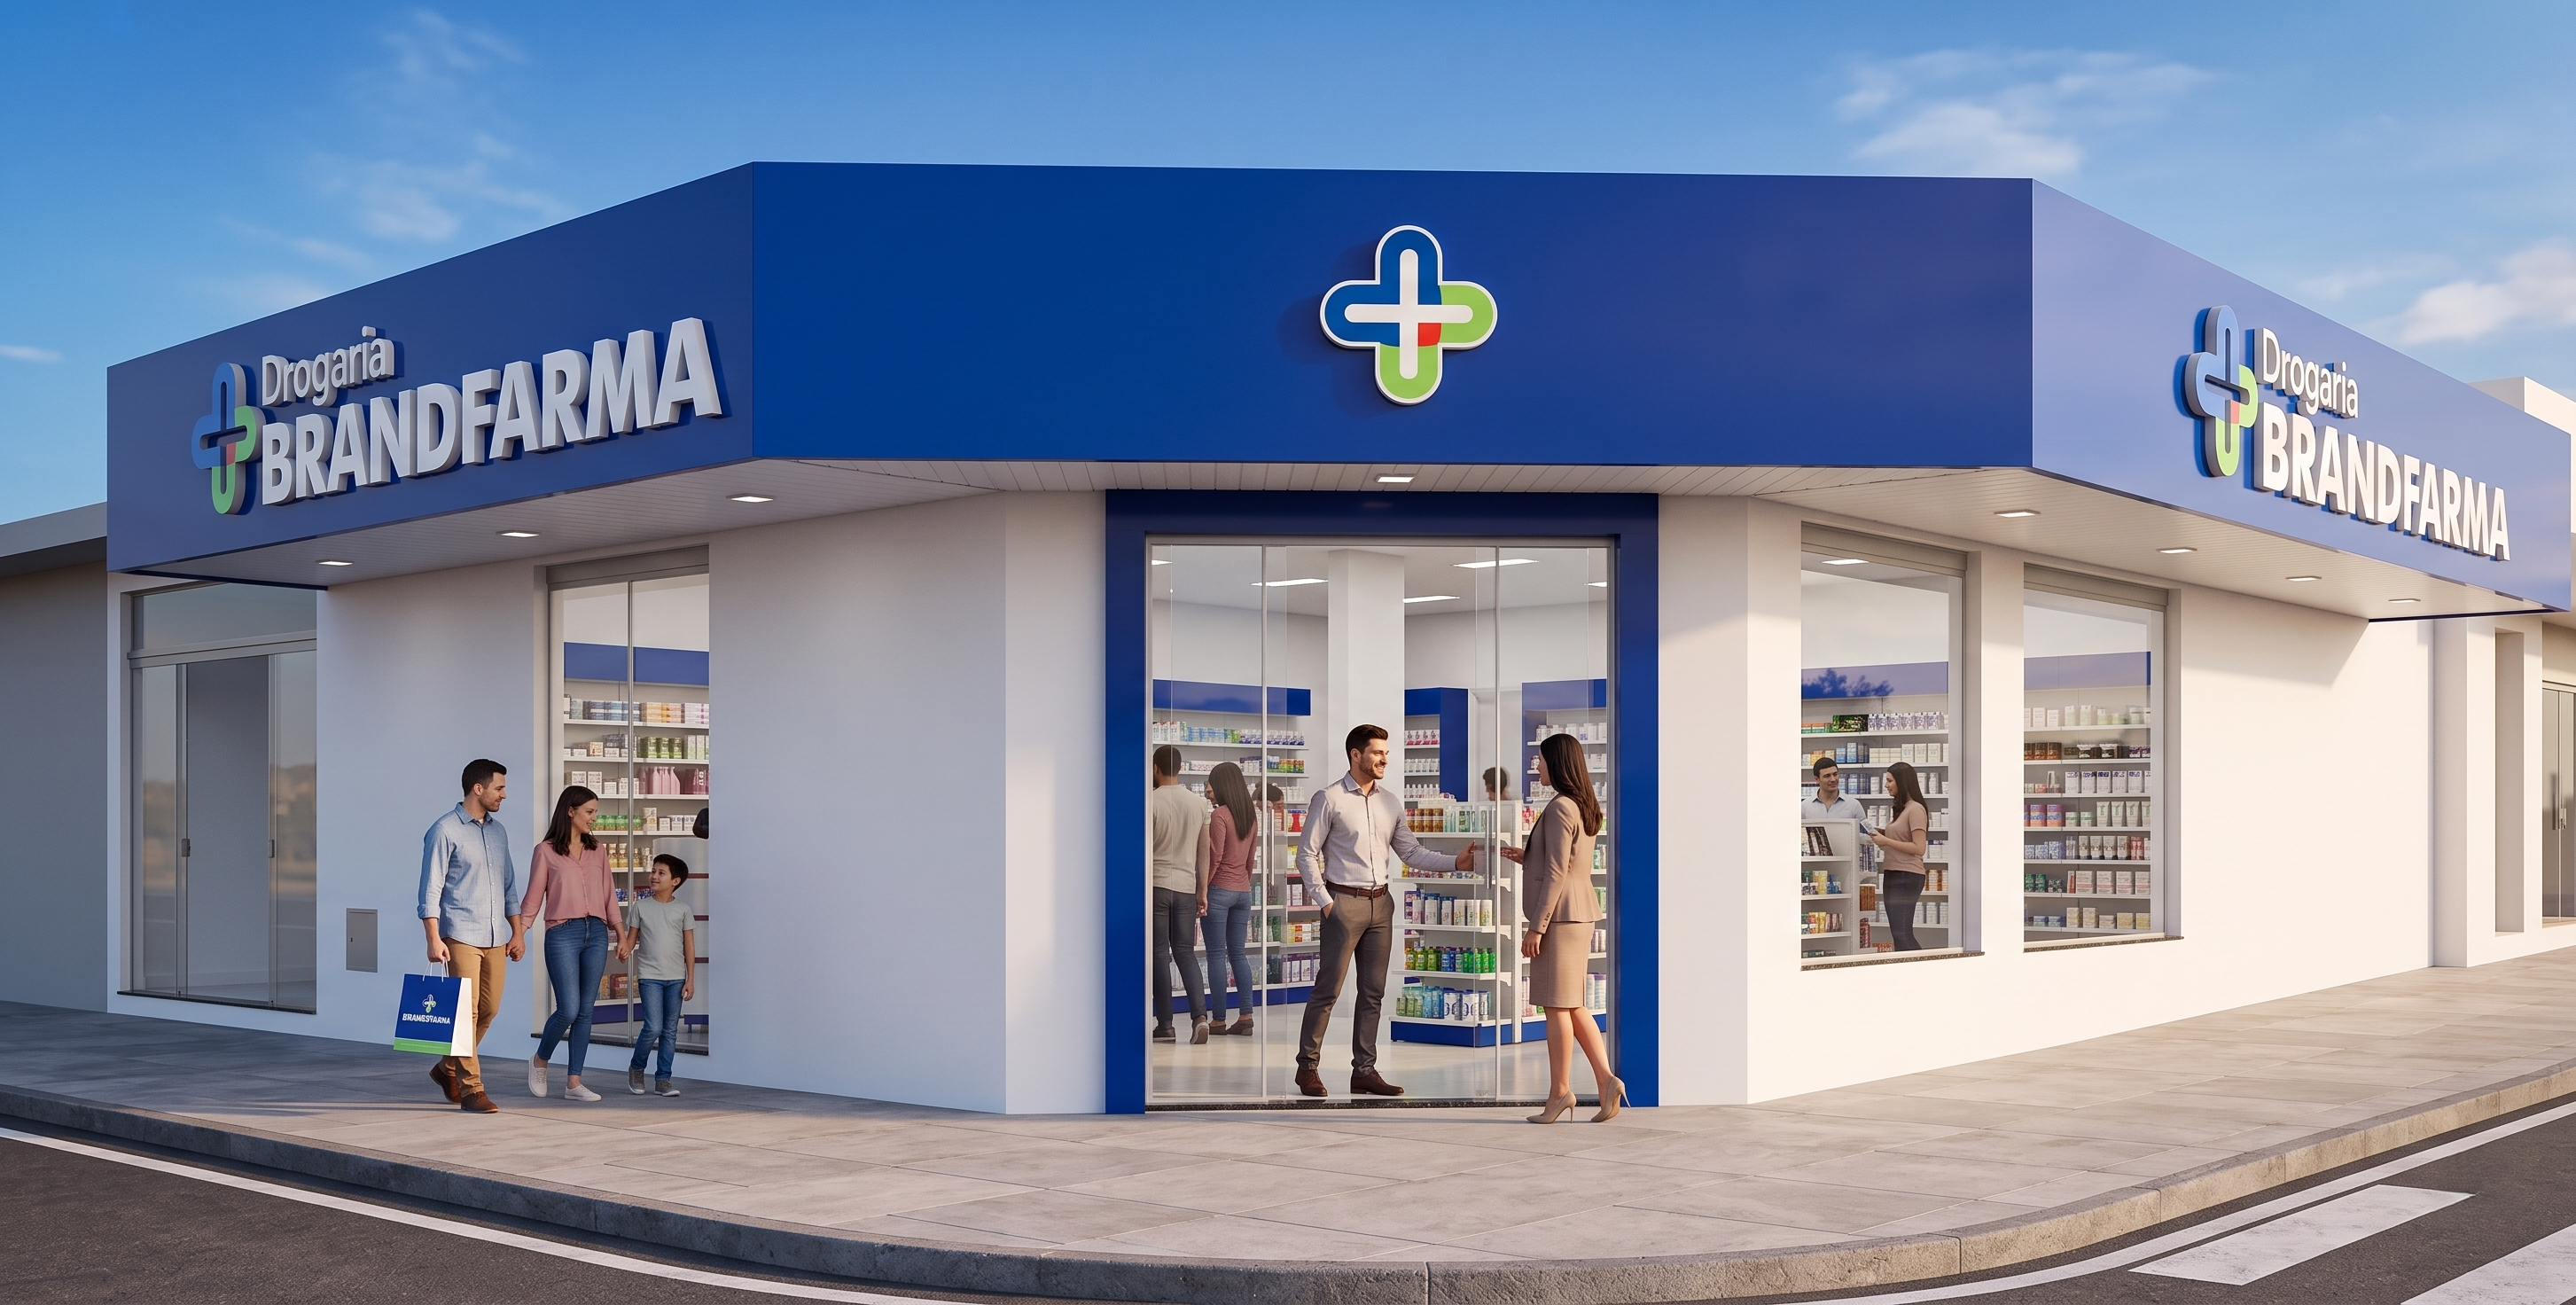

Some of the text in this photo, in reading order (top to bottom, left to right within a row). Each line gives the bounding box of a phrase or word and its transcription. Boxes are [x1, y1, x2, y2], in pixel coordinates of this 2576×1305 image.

[262, 325, 394, 407] Drogaria
[262, 316, 722, 506] BRANDFARMA
[2259, 327, 2359, 418] Drogaria
[2259, 402, 2510, 561] BRANDFARMA
